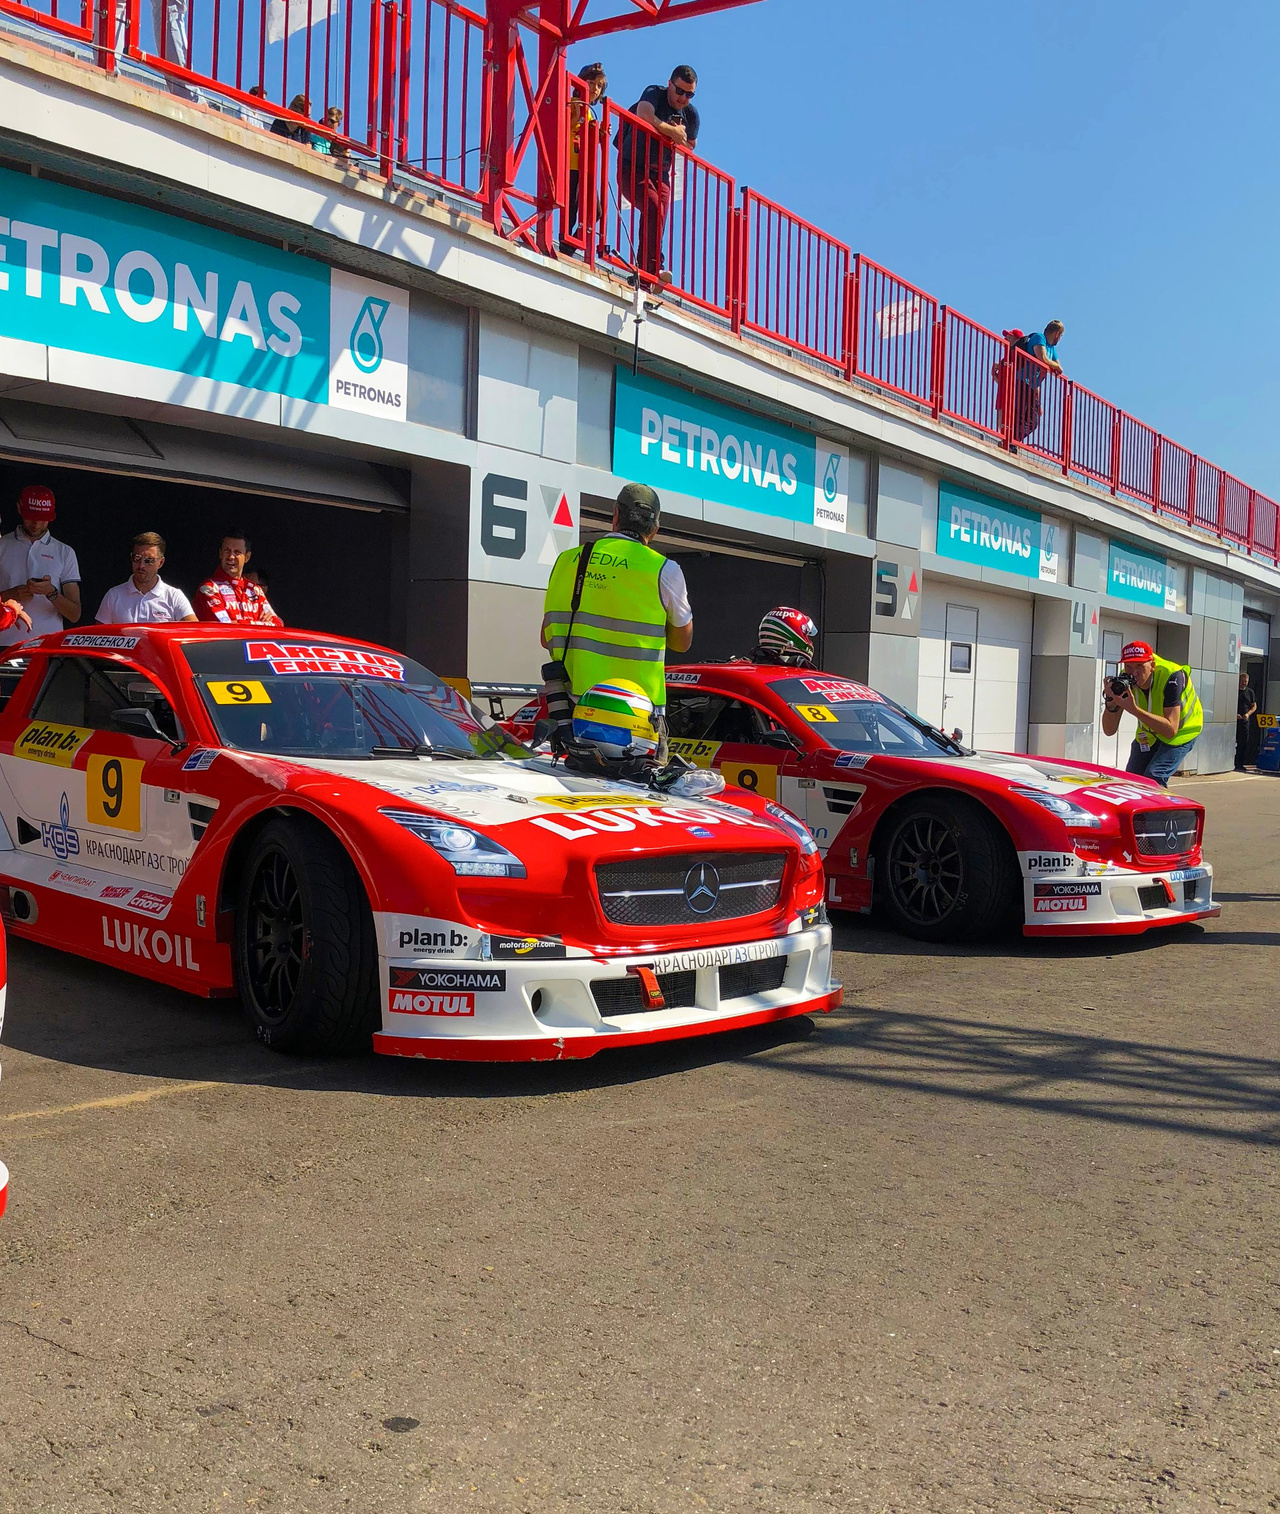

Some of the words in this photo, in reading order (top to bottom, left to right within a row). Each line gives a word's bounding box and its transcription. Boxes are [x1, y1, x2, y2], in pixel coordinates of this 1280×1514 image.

[336, 378, 401, 408] PETRONAS
[641, 407, 797, 496] PETRONAS
[481, 473, 528, 560] 6
[816, 508, 844, 523] PETRONAS
[950, 506, 1032, 559] PETRONAS
[1113, 557, 1162, 594] PETRONAS
[876, 560, 898, 617] 5
[1072, 602, 1085, 644] 4
[71, 636, 124, 648] БОРИСЕНКО
[246, 642, 404, 669] ARCTIC
[272, 661, 404, 681] ENERGY
[226, 683, 253, 702] 9
[807, 707, 826, 720] 8
[1260, 716, 1273, 726] 83
[20, 726, 60, 749] plan
[63, 730, 81, 751] b:
[27, 747, 43, 758] energy
[44, 749, 56, 758] drink
[102, 759, 122, 818] 9
[529, 807, 775, 840] LUKOIL
[1028, 854, 1061, 870] plan
[1063, 854, 1074, 867] b:
[1052, 884, 1100, 894] YOKOHAMA
[130, 897, 166, 912] СПОРТ
[1036, 898, 1085, 911] MOTUL
[102, 916, 200, 972] LUKOIL
[399, 928, 446, 948] plan
[450, 929, 468, 947] b:
[499, 940, 556, 950] motorsport.com
[653, 940, 779, 974] КРАСНОДАРГАЗСТРОЙ
[418, 973, 501, 987] YOKOHAMA
[392, 993, 471, 1014] MOTUL
